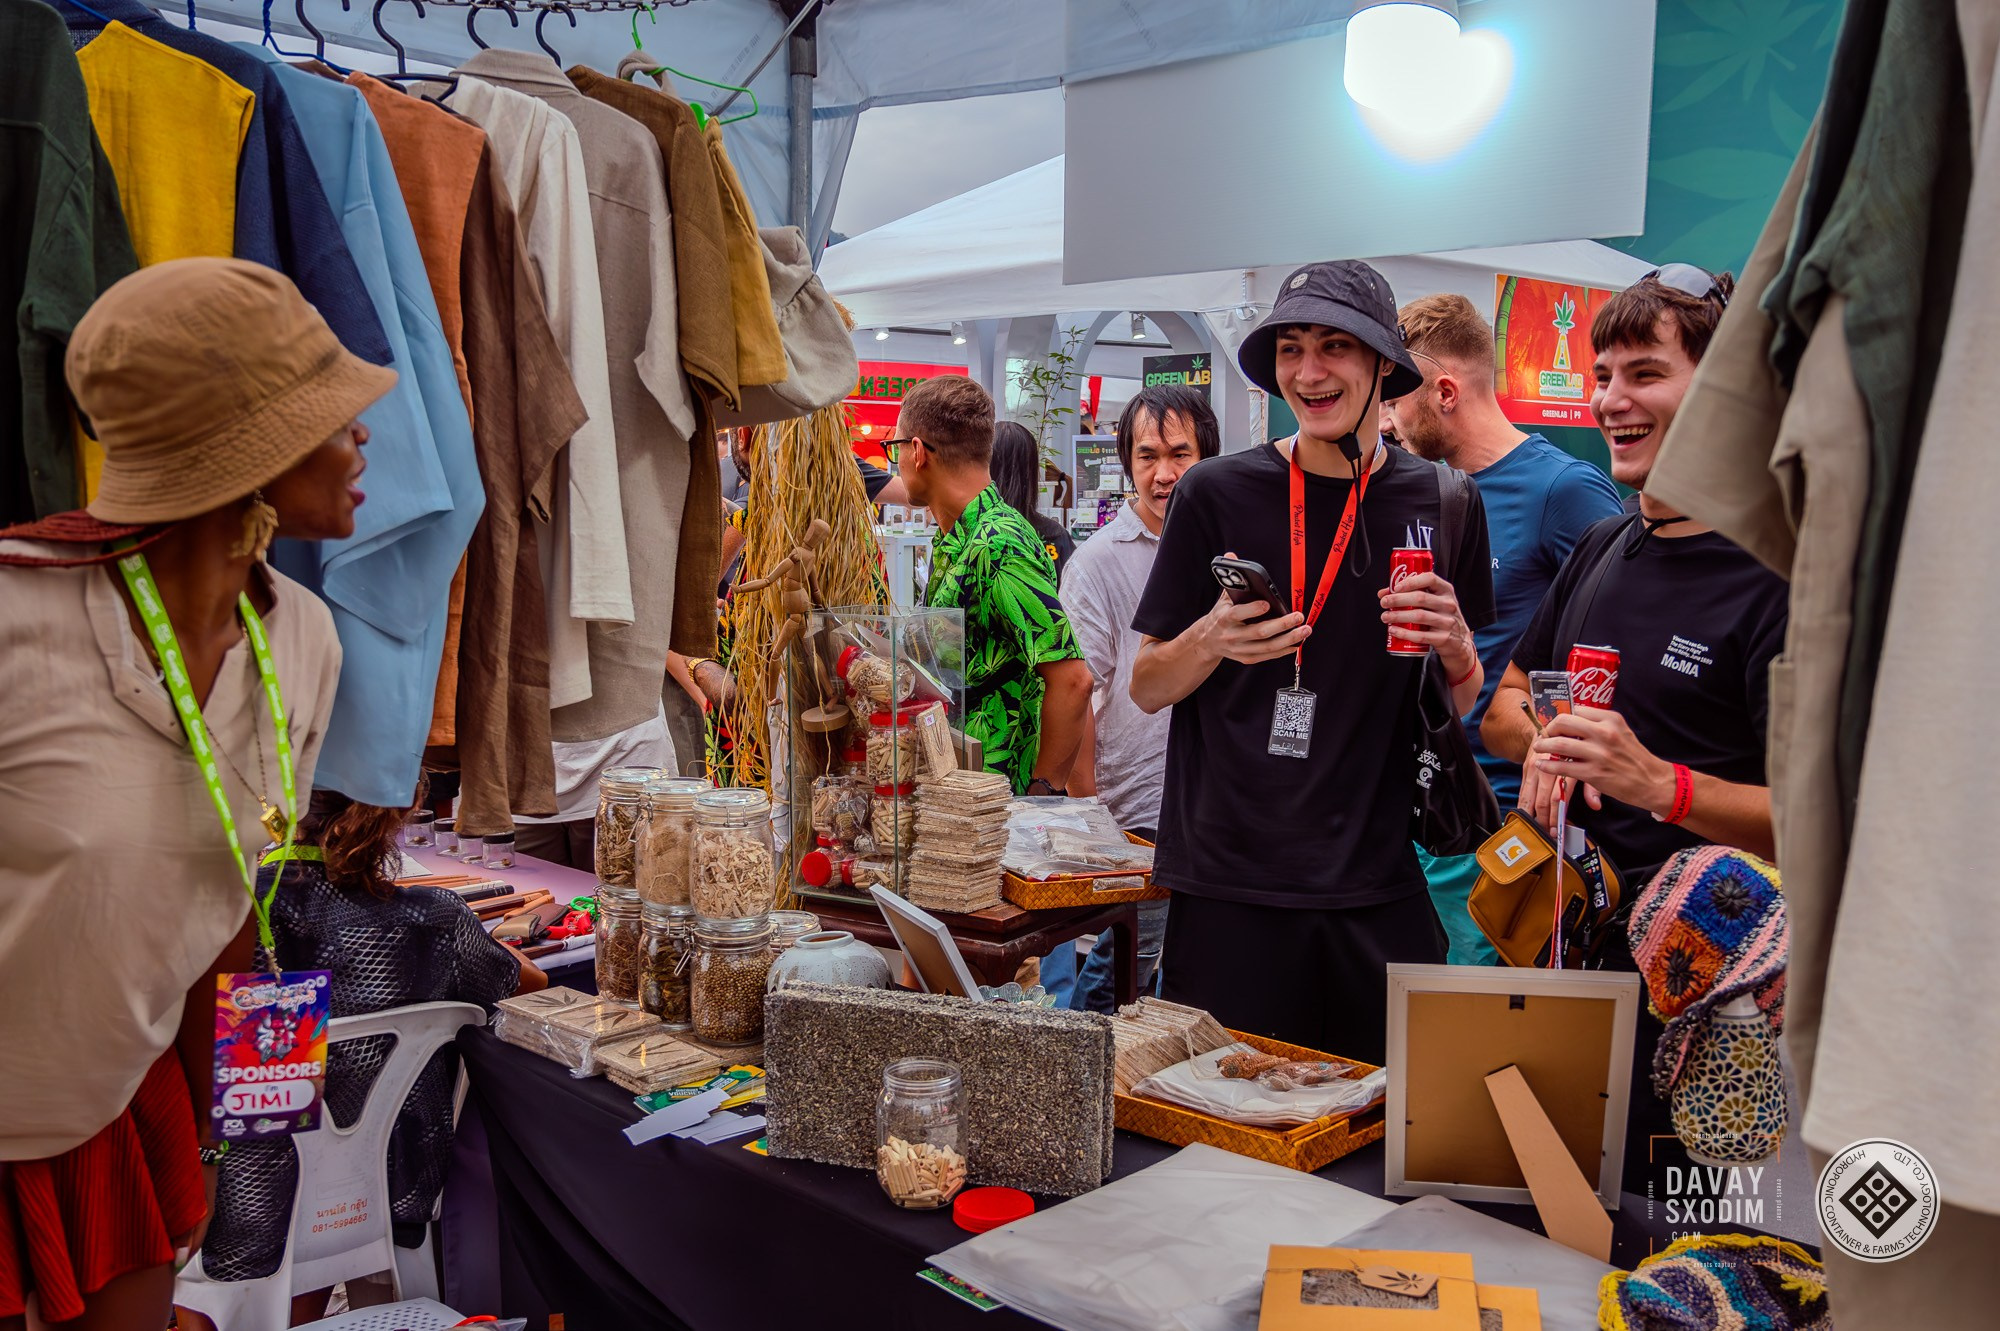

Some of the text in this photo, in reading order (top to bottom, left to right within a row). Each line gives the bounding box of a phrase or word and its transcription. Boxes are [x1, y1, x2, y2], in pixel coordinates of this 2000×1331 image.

[1145, 370, 1211, 388] GREENLAB
[1540, 371, 1583, 389] GREENLAB
[1542, 409, 1568, 419] GREENLAB
[1661, 653, 1699, 678] MoMA
[1273, 729, 1309, 740] SCAN ME
[217, 1061, 322, 1084] SPONSORS
[231, 1089, 291, 1111] JIMI
